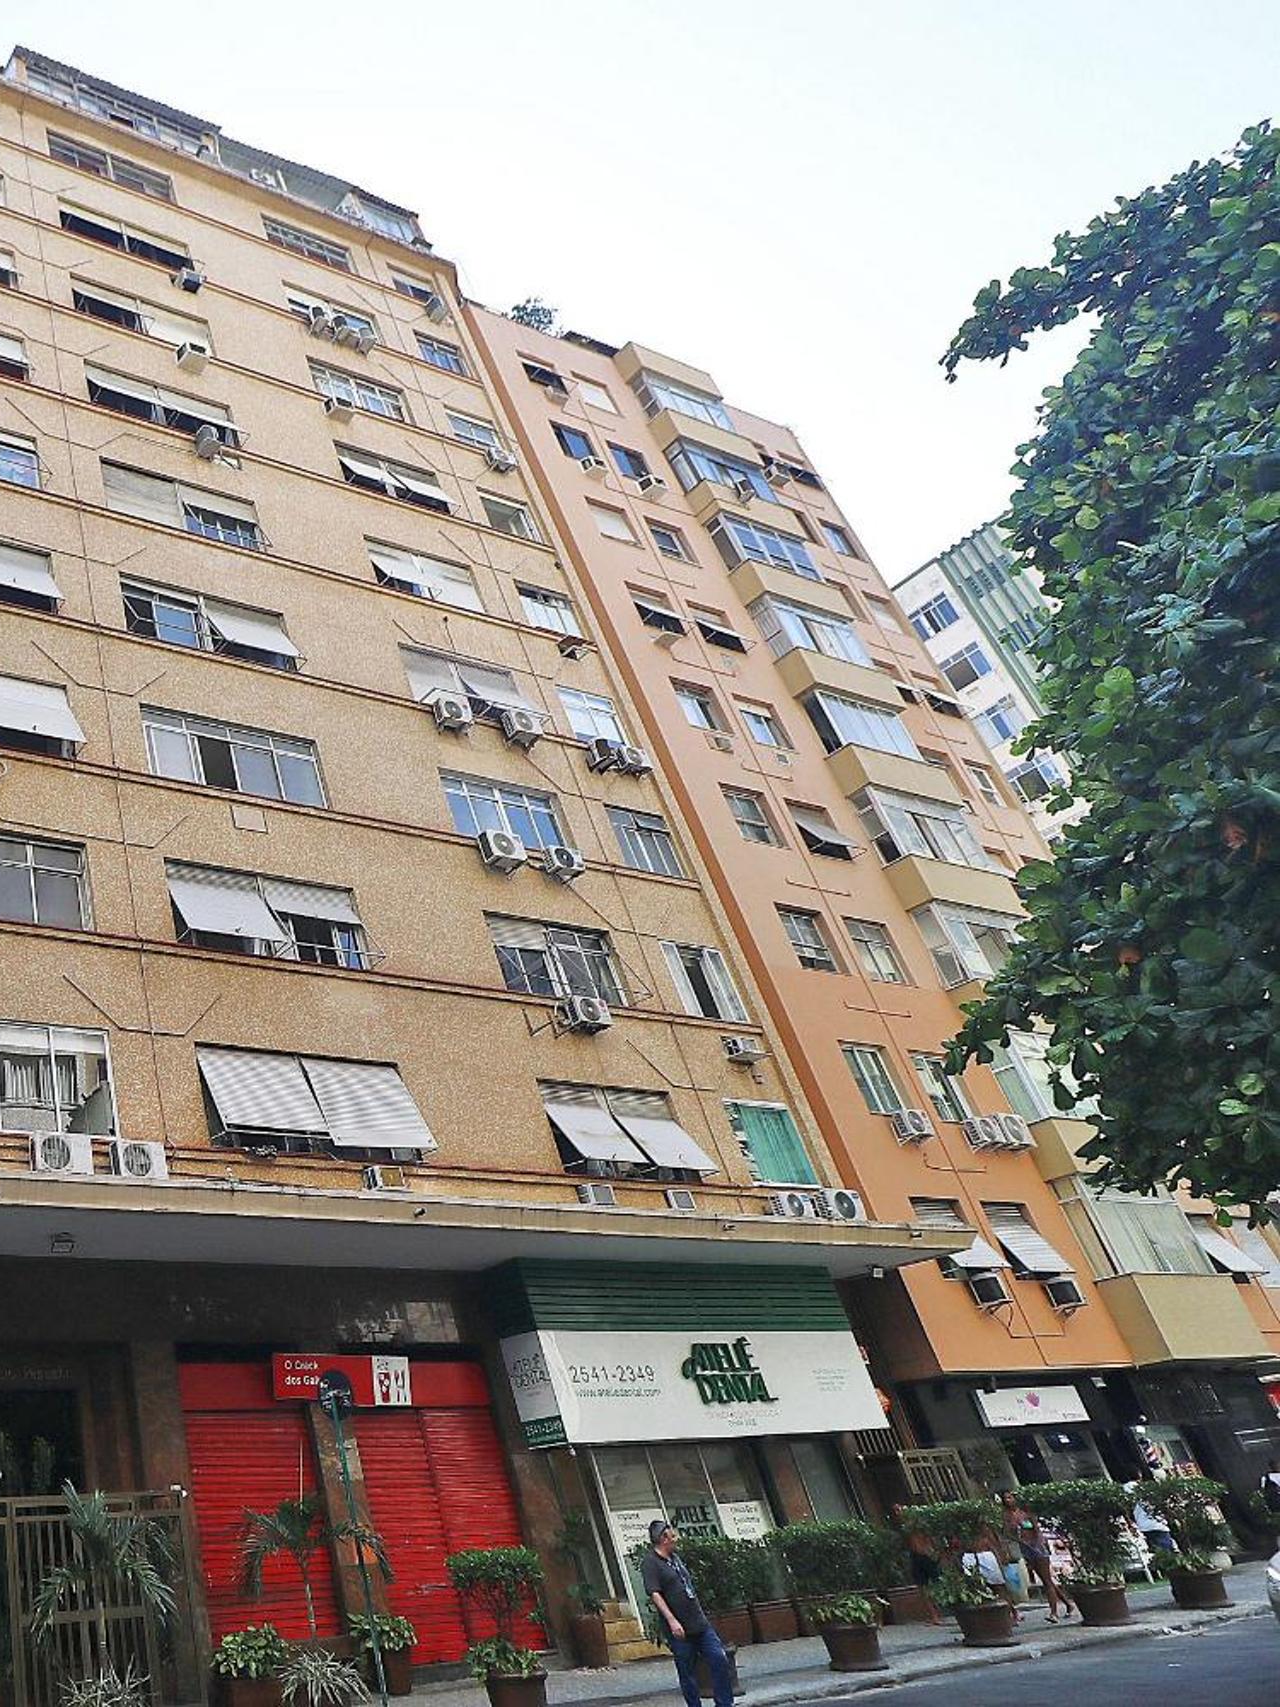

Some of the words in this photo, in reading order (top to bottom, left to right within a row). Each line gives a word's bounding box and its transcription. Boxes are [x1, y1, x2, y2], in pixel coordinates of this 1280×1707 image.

[285, 1375, 302, 1385] dos
[571, 1365, 655, 1383] 2541-2349
[696, 1373, 779, 1404] DENTAL
